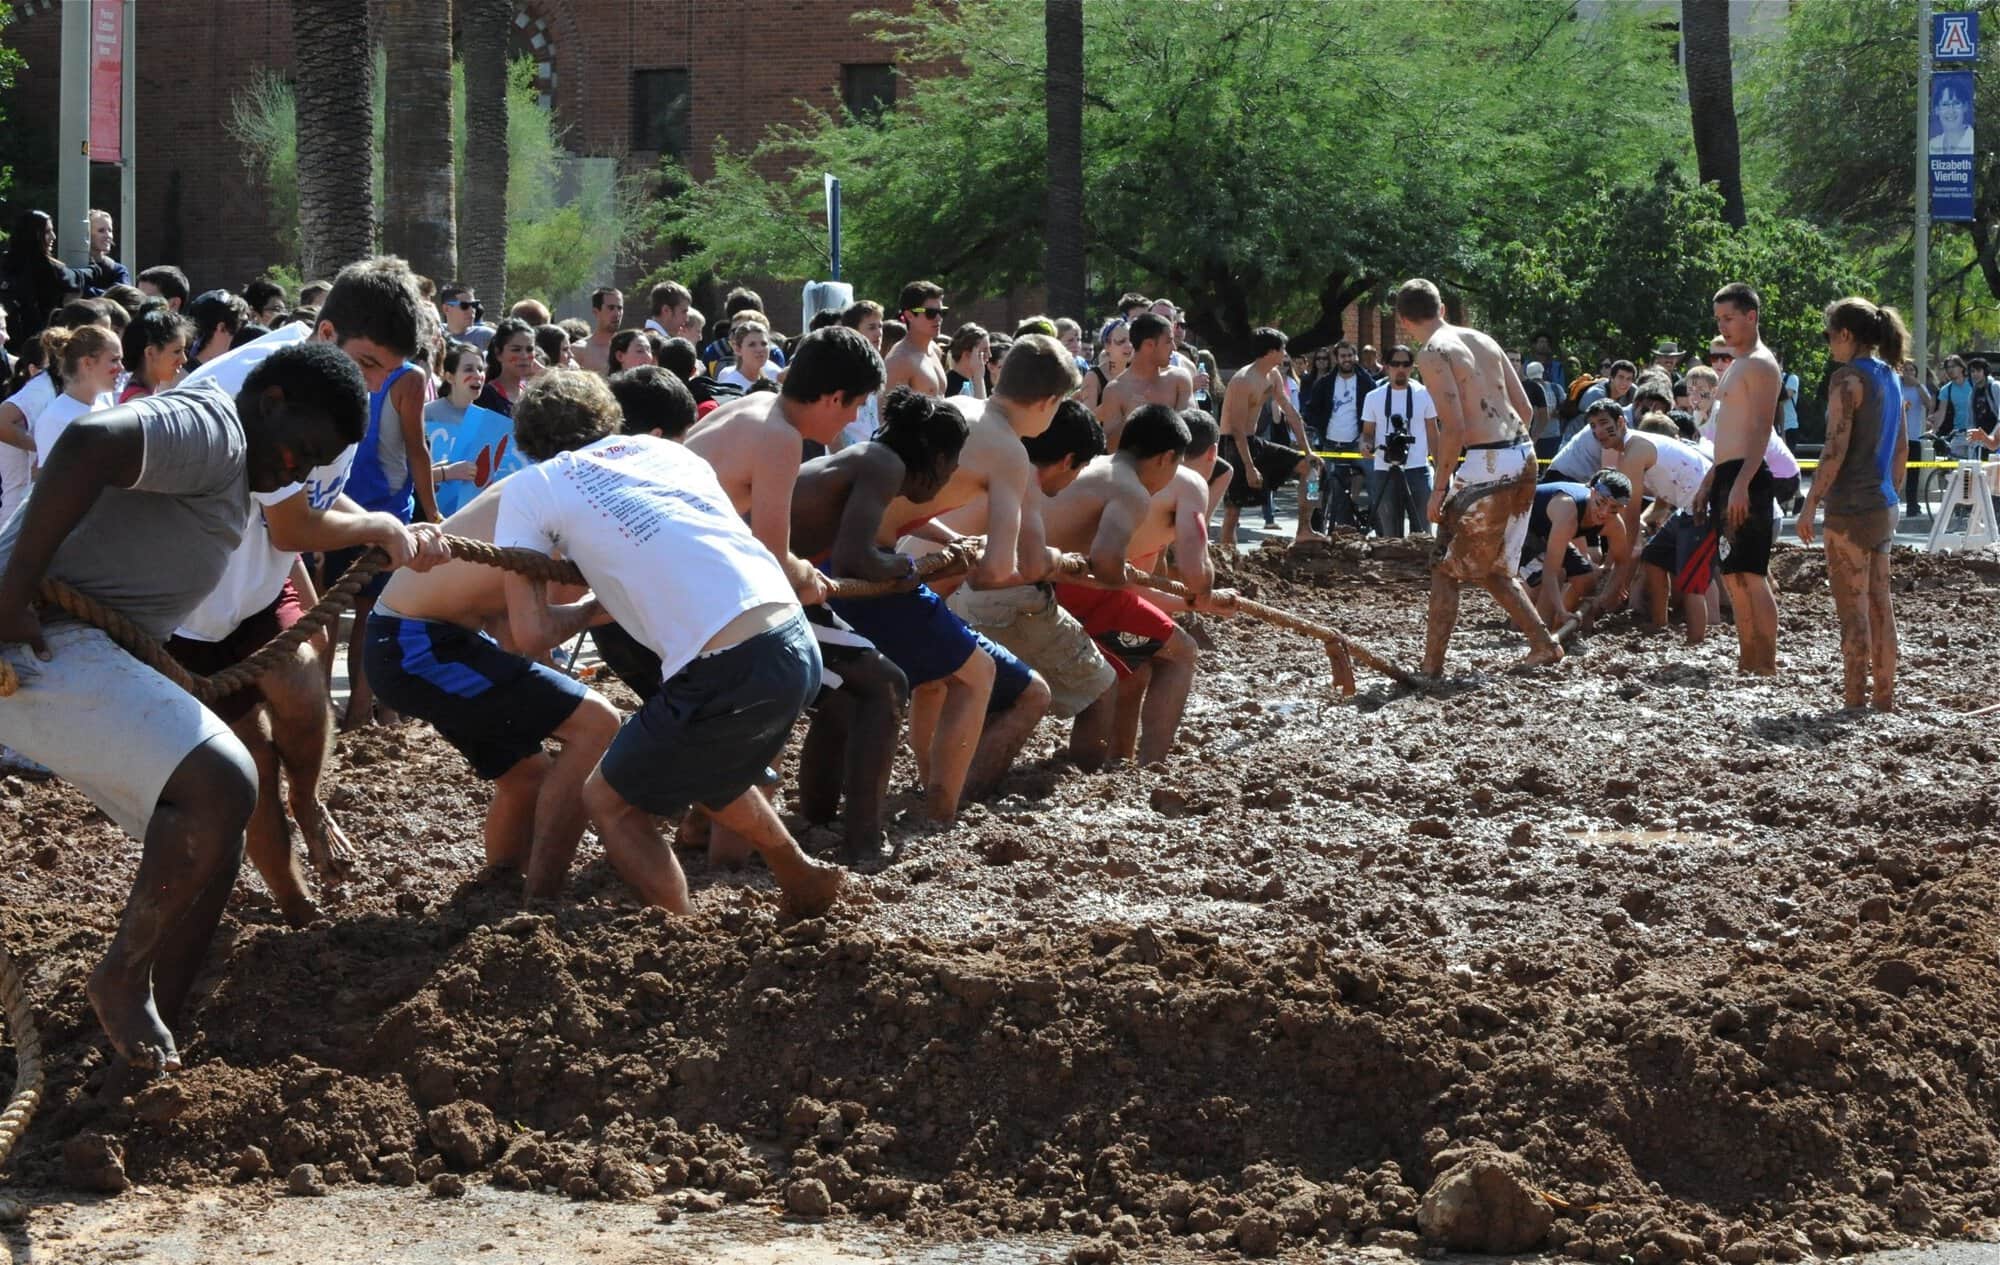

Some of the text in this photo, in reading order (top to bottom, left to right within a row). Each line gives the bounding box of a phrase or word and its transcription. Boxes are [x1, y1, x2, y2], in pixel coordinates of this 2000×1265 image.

[1936, 17, 1974, 57] A
[1931, 159, 1972, 170] Elizabeth
[1934, 171, 1968, 184] Vierling
